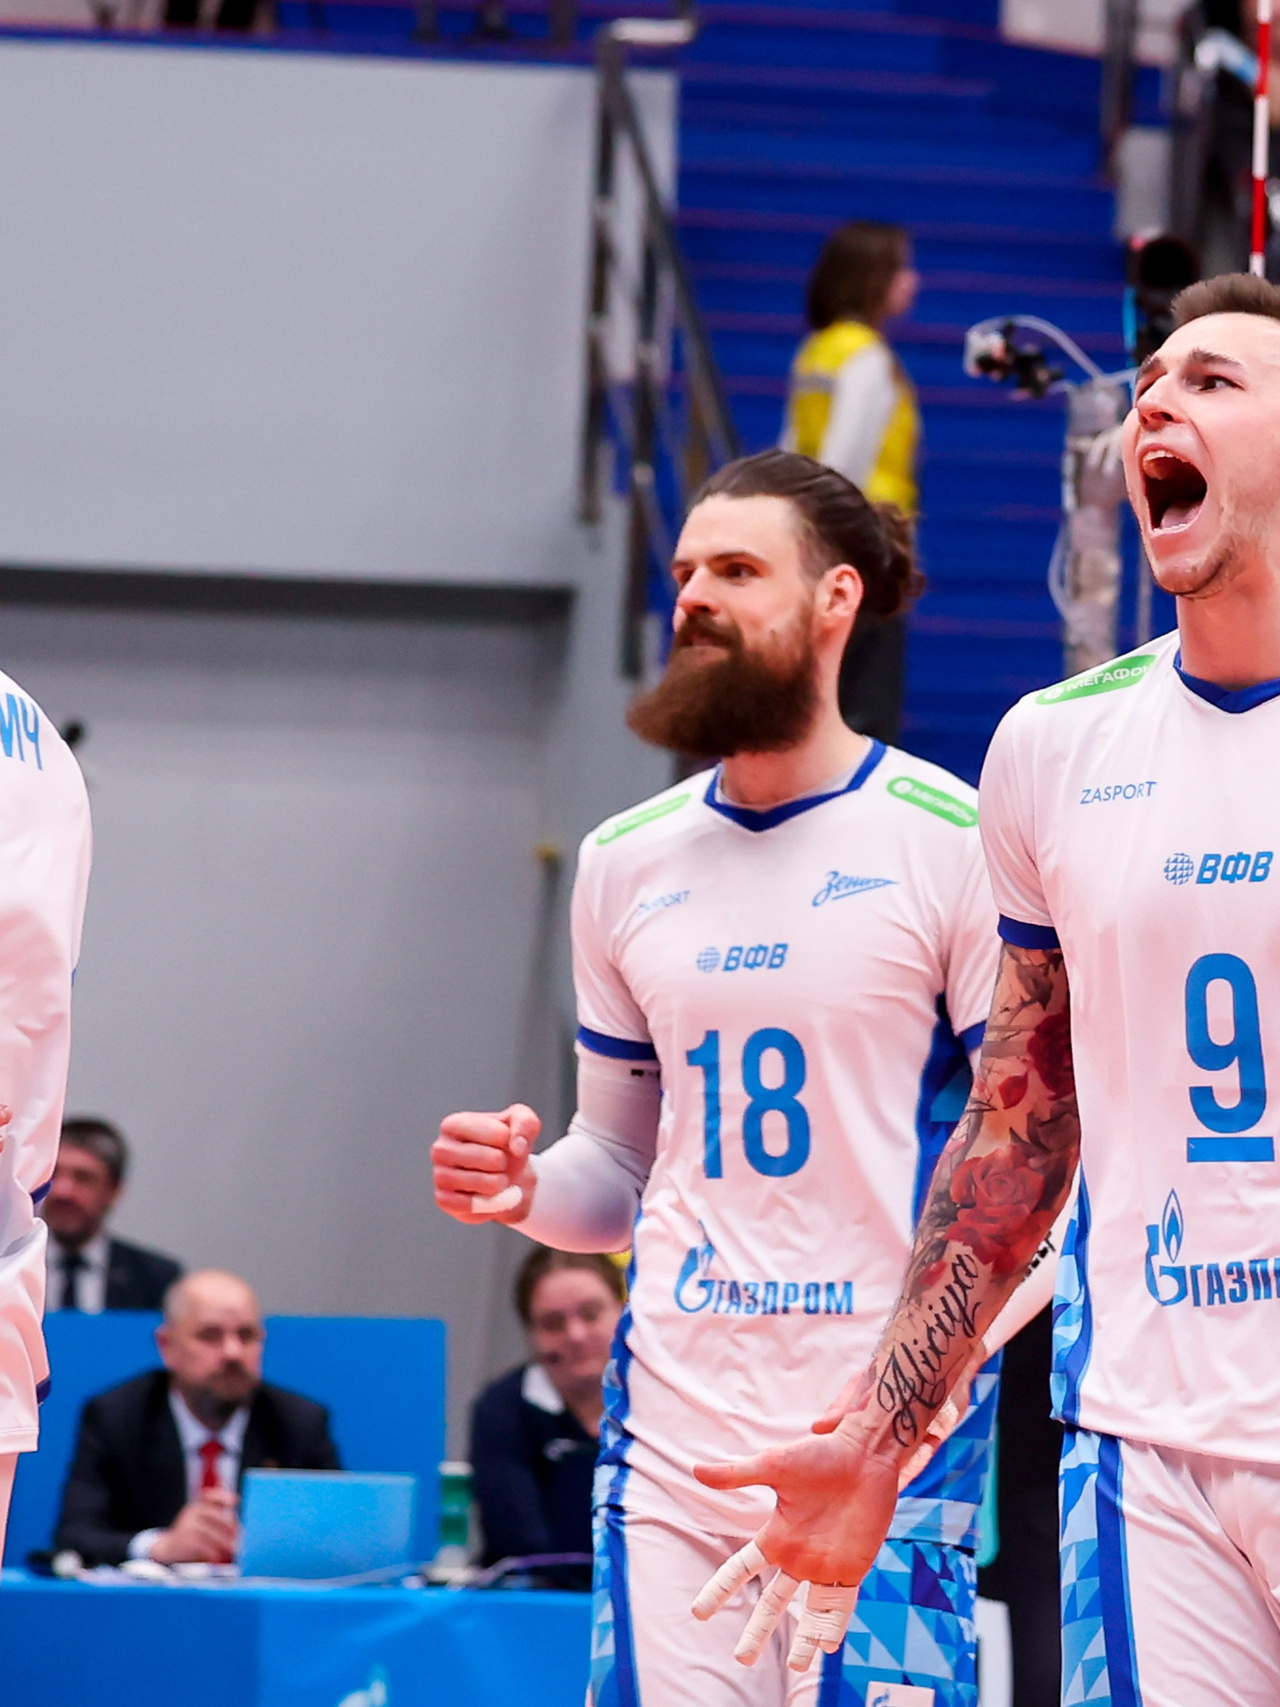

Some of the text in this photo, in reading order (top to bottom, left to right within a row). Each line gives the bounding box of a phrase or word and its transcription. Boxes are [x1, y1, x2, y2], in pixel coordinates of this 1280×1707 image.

[1079, 781, 1157, 805] ZASPORT
[1196, 851, 1274, 884] ВФВ
[721, 943, 788, 972] ВФВ
[1185, 952, 1267, 1134] 9
[685, 1027, 811, 1179] 18
[712, 1280, 853, 1315] ГАЗПРОМ
